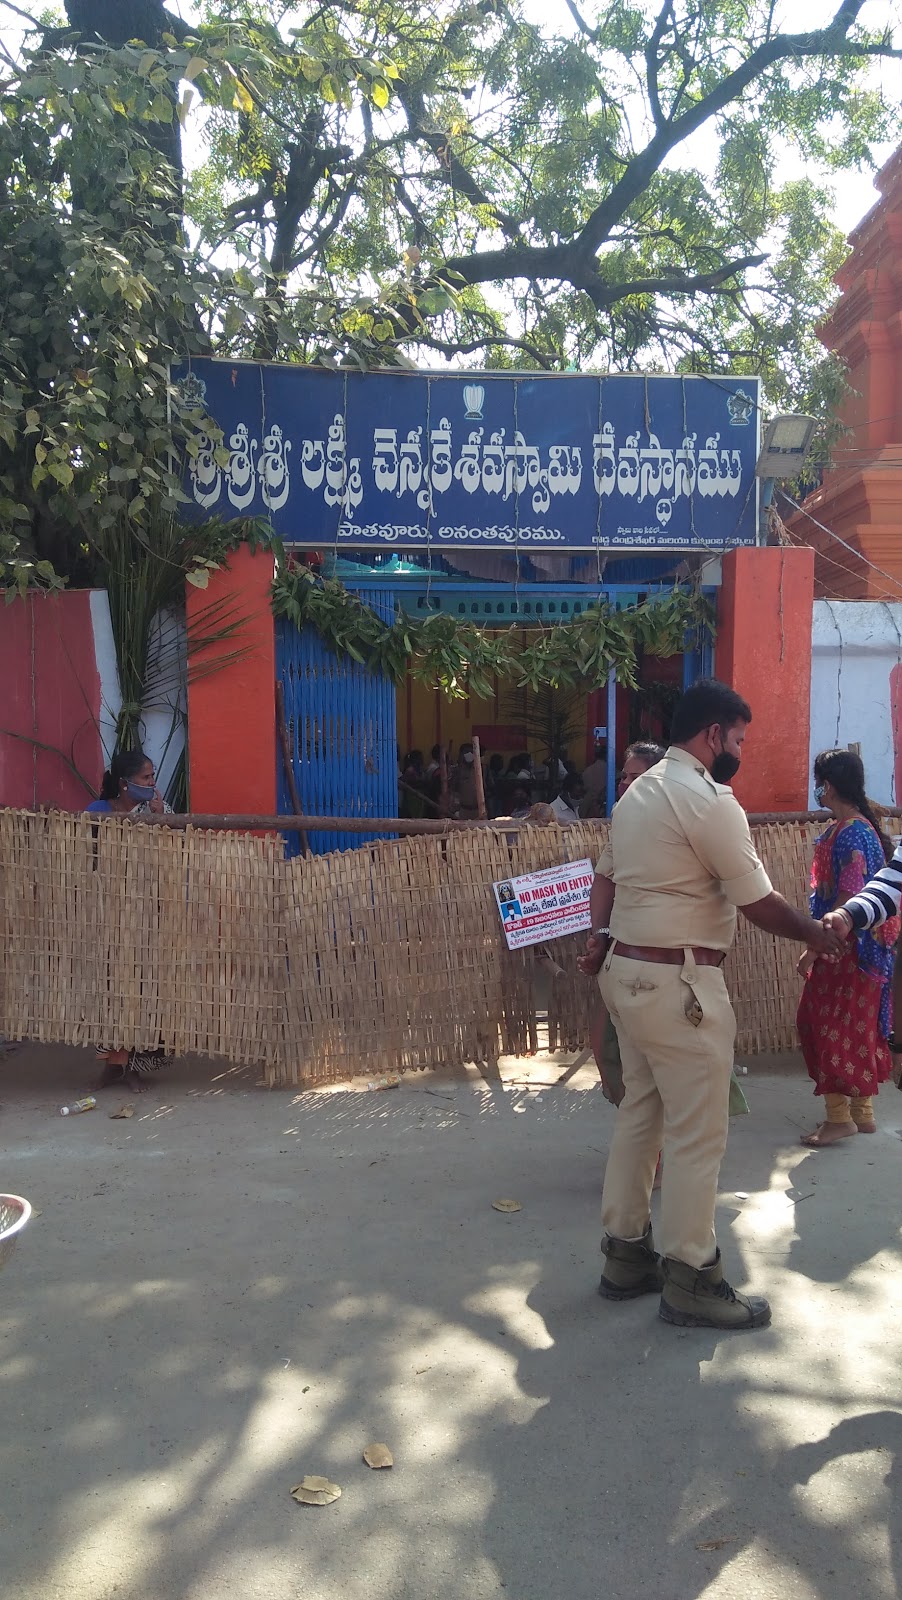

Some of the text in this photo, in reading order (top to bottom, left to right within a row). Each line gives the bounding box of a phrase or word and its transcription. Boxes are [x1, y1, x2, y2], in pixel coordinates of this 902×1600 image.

[592, 421, 743, 527] దేవస్థానము
[657, 536, 689, 545] మరియు
[519, 874, 593, 904] NO MASK NO ENTRY
